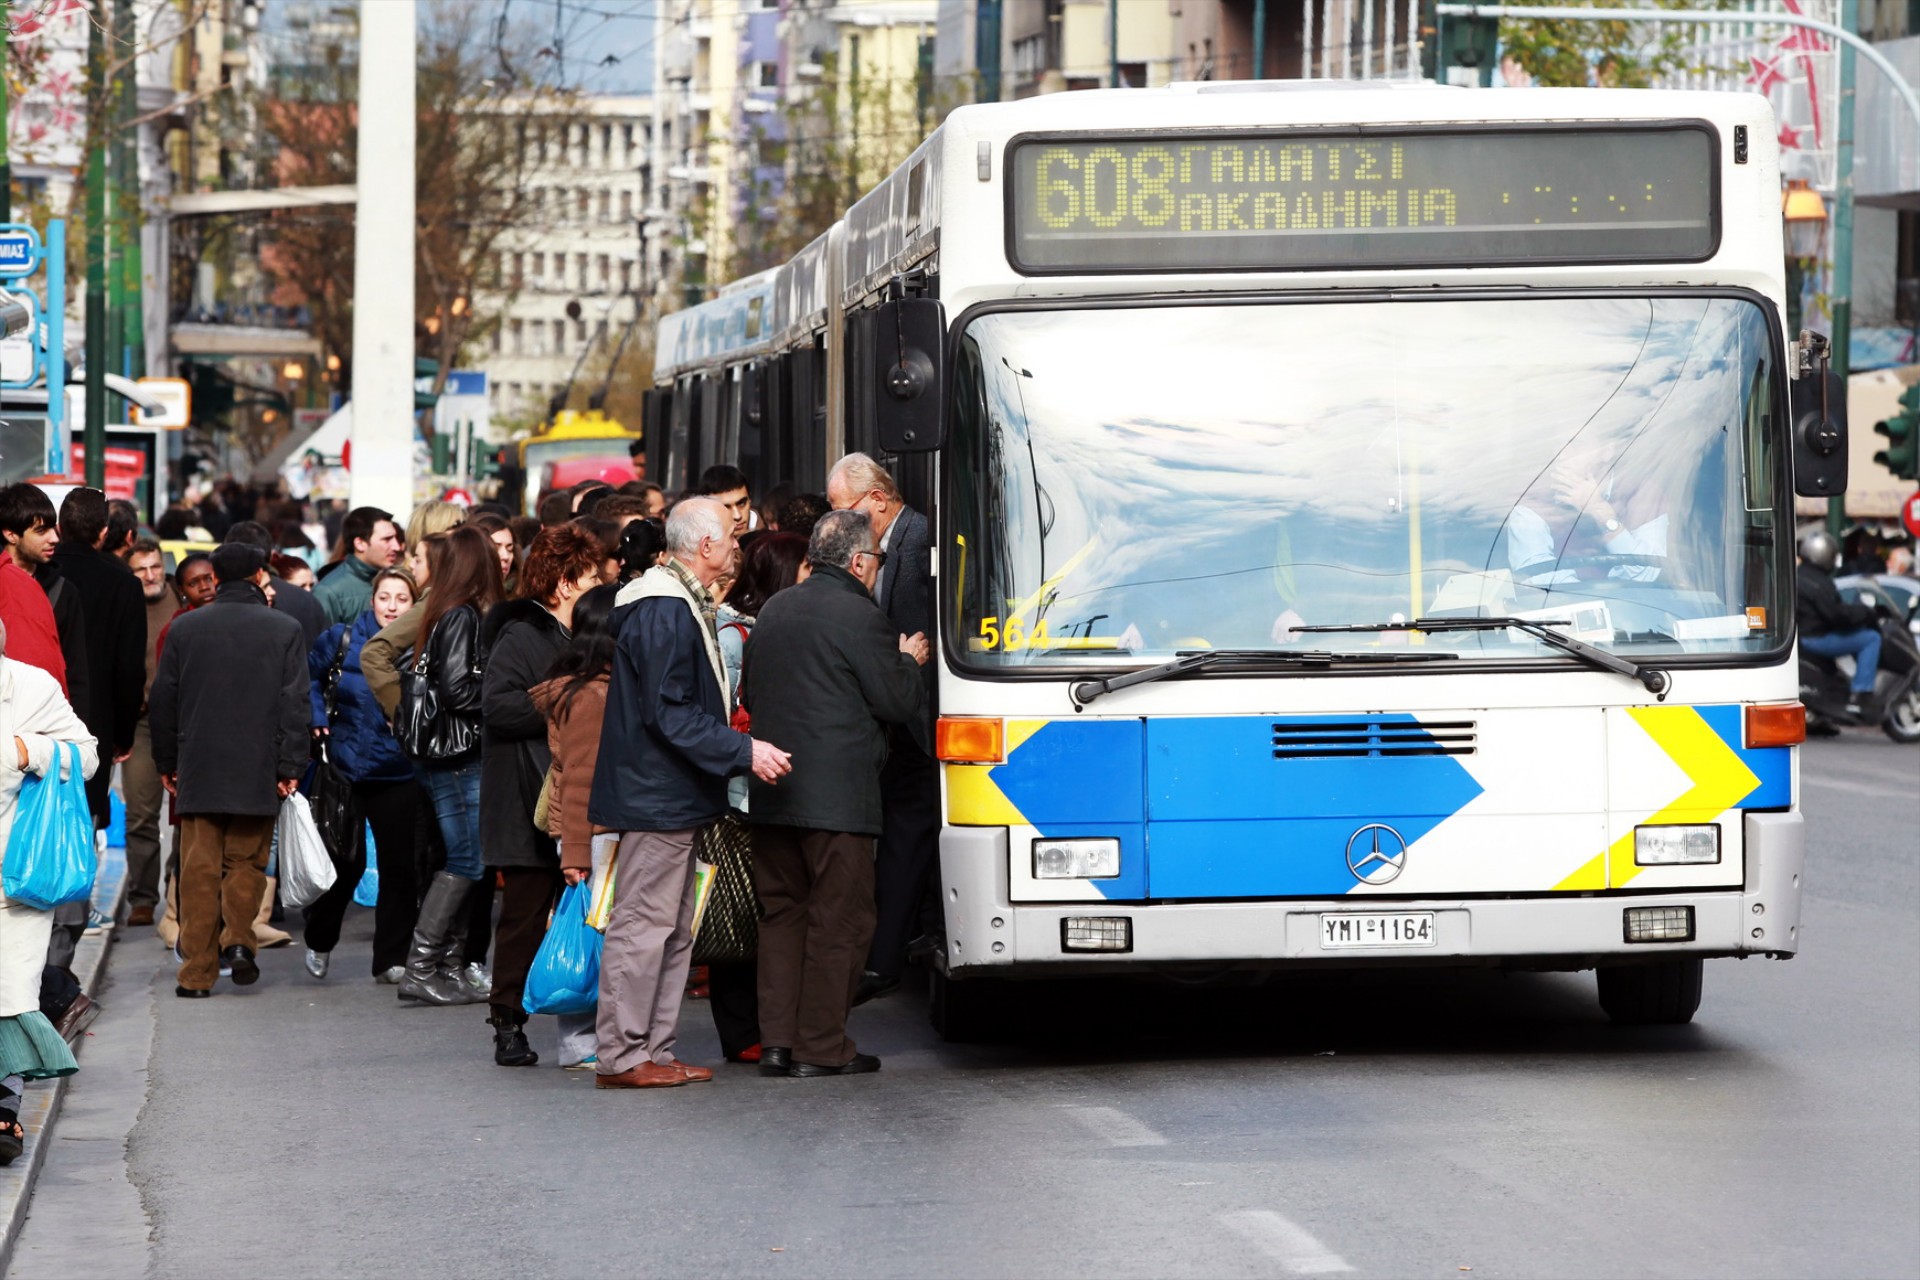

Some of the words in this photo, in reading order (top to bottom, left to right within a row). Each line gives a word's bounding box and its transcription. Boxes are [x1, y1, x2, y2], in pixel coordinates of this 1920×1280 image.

[1180, 143, 1402, 183] ΓΑΛΑΤΣΙ
[1036, 147, 1175, 228] 608
[1180, 188, 1456, 231] ΑΚΑΔΗΜΙΑ
[979, 616, 1049, 650] 564
